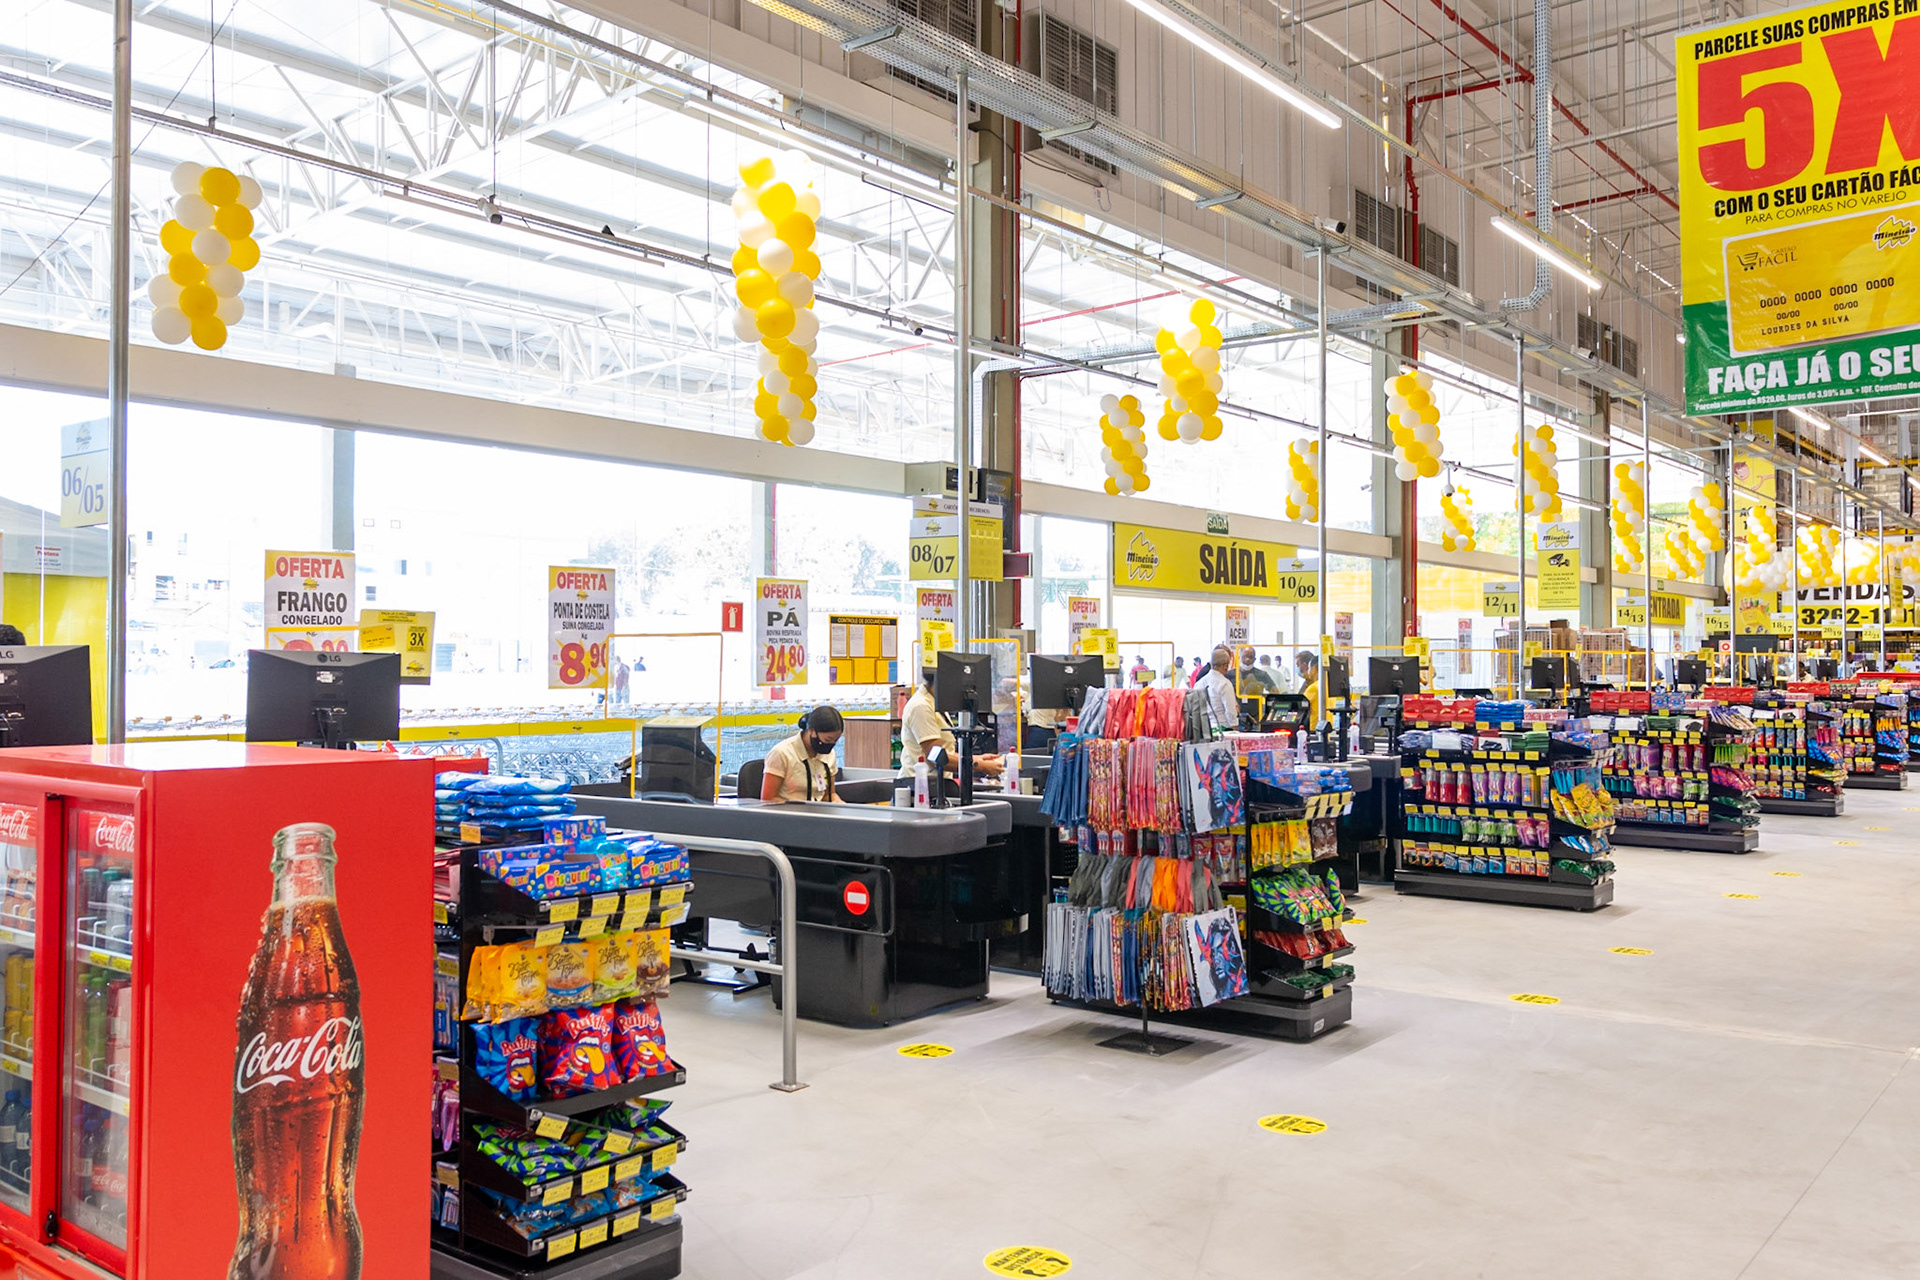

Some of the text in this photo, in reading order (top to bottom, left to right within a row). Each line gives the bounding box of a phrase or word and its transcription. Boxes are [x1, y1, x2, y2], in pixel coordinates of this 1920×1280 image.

[1694, 0, 1918, 60] PARCELE SUAS COMPRAS EM
[1698, 15, 1920, 192] 5X
[1714, 194, 1753, 218] COM
[1758, 192, 1769, 210] O
[1774, 186, 1806, 207] SEU
[1812, 172, 1884, 201] CARTÃO
[1746, 190, 1907, 225] PARA COMPRAS NO VAREJO
[1760, 277, 1895, 309] 0000 0000 0000 0000
[1776, 300, 1859, 321] 00/00 00/00
[1761, 314, 1850, 336] LOURDES DA SILVA
[1707, 360, 1789, 396] FAÇA
[1794, 347, 1832, 386] JÁ
[1838, 351, 1861, 381] O
[1207, 514, 1229, 531] SAÍDA
[275, 556, 345, 579] OFERTA
[1199, 541, 1268, 589] SAÍDA
[556, 571, 608, 591] OFERTA
[763, 583, 802, 600] OFERTA
[277, 591, 348, 613] FRANGO
[921, 592, 953, 607] OFERTA
[1072, 601, 1097, 613] OFERTA
[282, 614, 343, 625] CONGELADO
[553, 602, 610, 620] PONTA DE COSTELA
[767, 607, 800, 627] PÁ
[577, 622, 605, 631] CONGELADA
[410, 632, 425, 646] 3X
[566, 1013, 611, 1039] Ruffles
[616, 1010, 660, 1035] Ruffles
[236, 1015, 362, 1095] Coca-Cola
[501, 1034, 538, 1056] Ruffles
